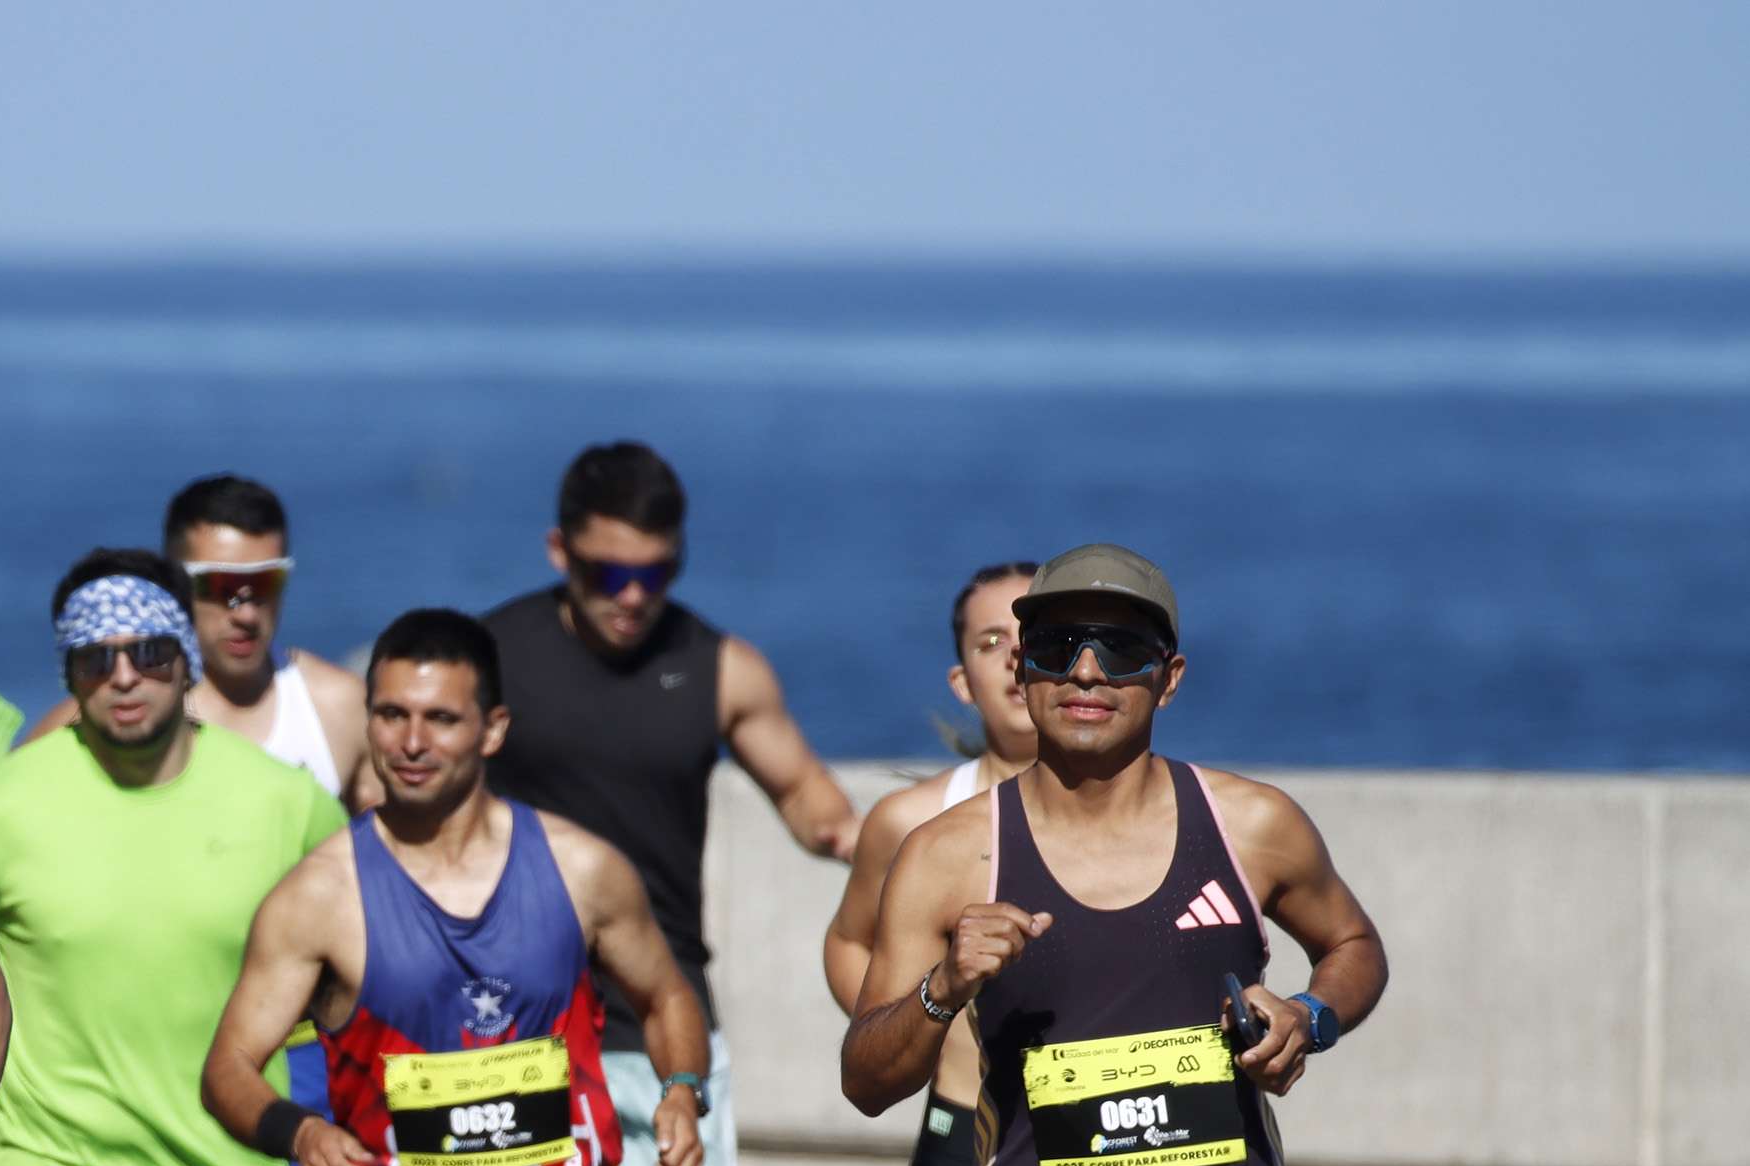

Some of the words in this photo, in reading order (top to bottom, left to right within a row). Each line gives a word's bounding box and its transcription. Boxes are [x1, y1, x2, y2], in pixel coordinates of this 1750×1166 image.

[1143, 1035, 1202, 1050] DECATHLON
[1101, 1064, 1156, 1081] BYD
[450, 1101, 517, 1136] 0632
[1100, 1094, 1169, 1132] 0631
[1160, 1146, 1231, 1165] REFORESTAR
